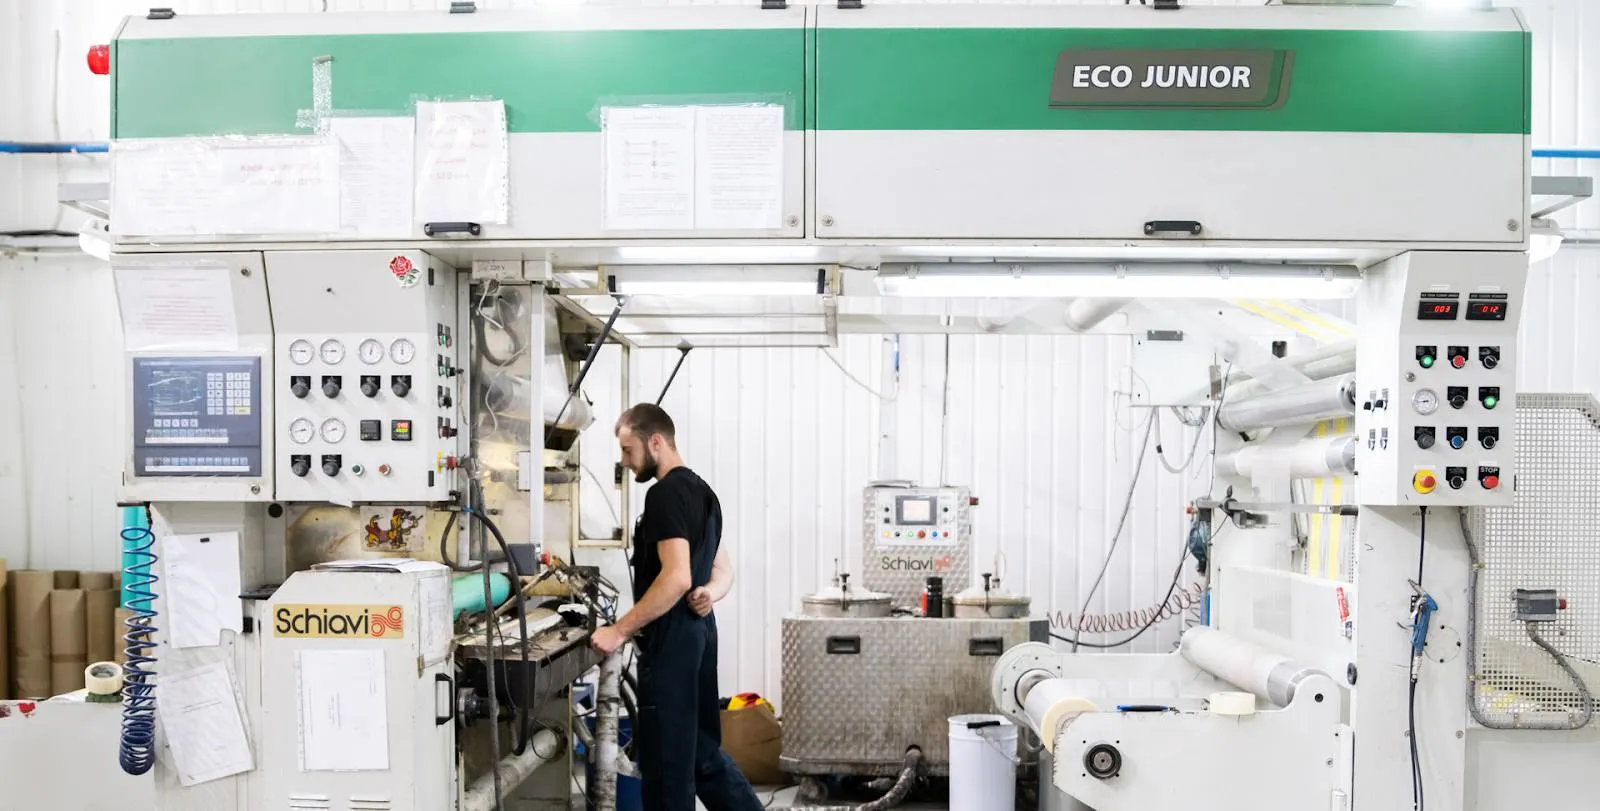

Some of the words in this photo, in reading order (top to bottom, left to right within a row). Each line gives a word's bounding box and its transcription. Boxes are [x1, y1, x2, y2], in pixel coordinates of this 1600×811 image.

[1072, 65, 1133, 88] ECO
[1141, 65, 1251, 88] JUNIOR
[1434, 305, 1450, 313] 003
[882, 556, 933, 571] Schiavi
[276, 607, 369, 634] Schiavi
